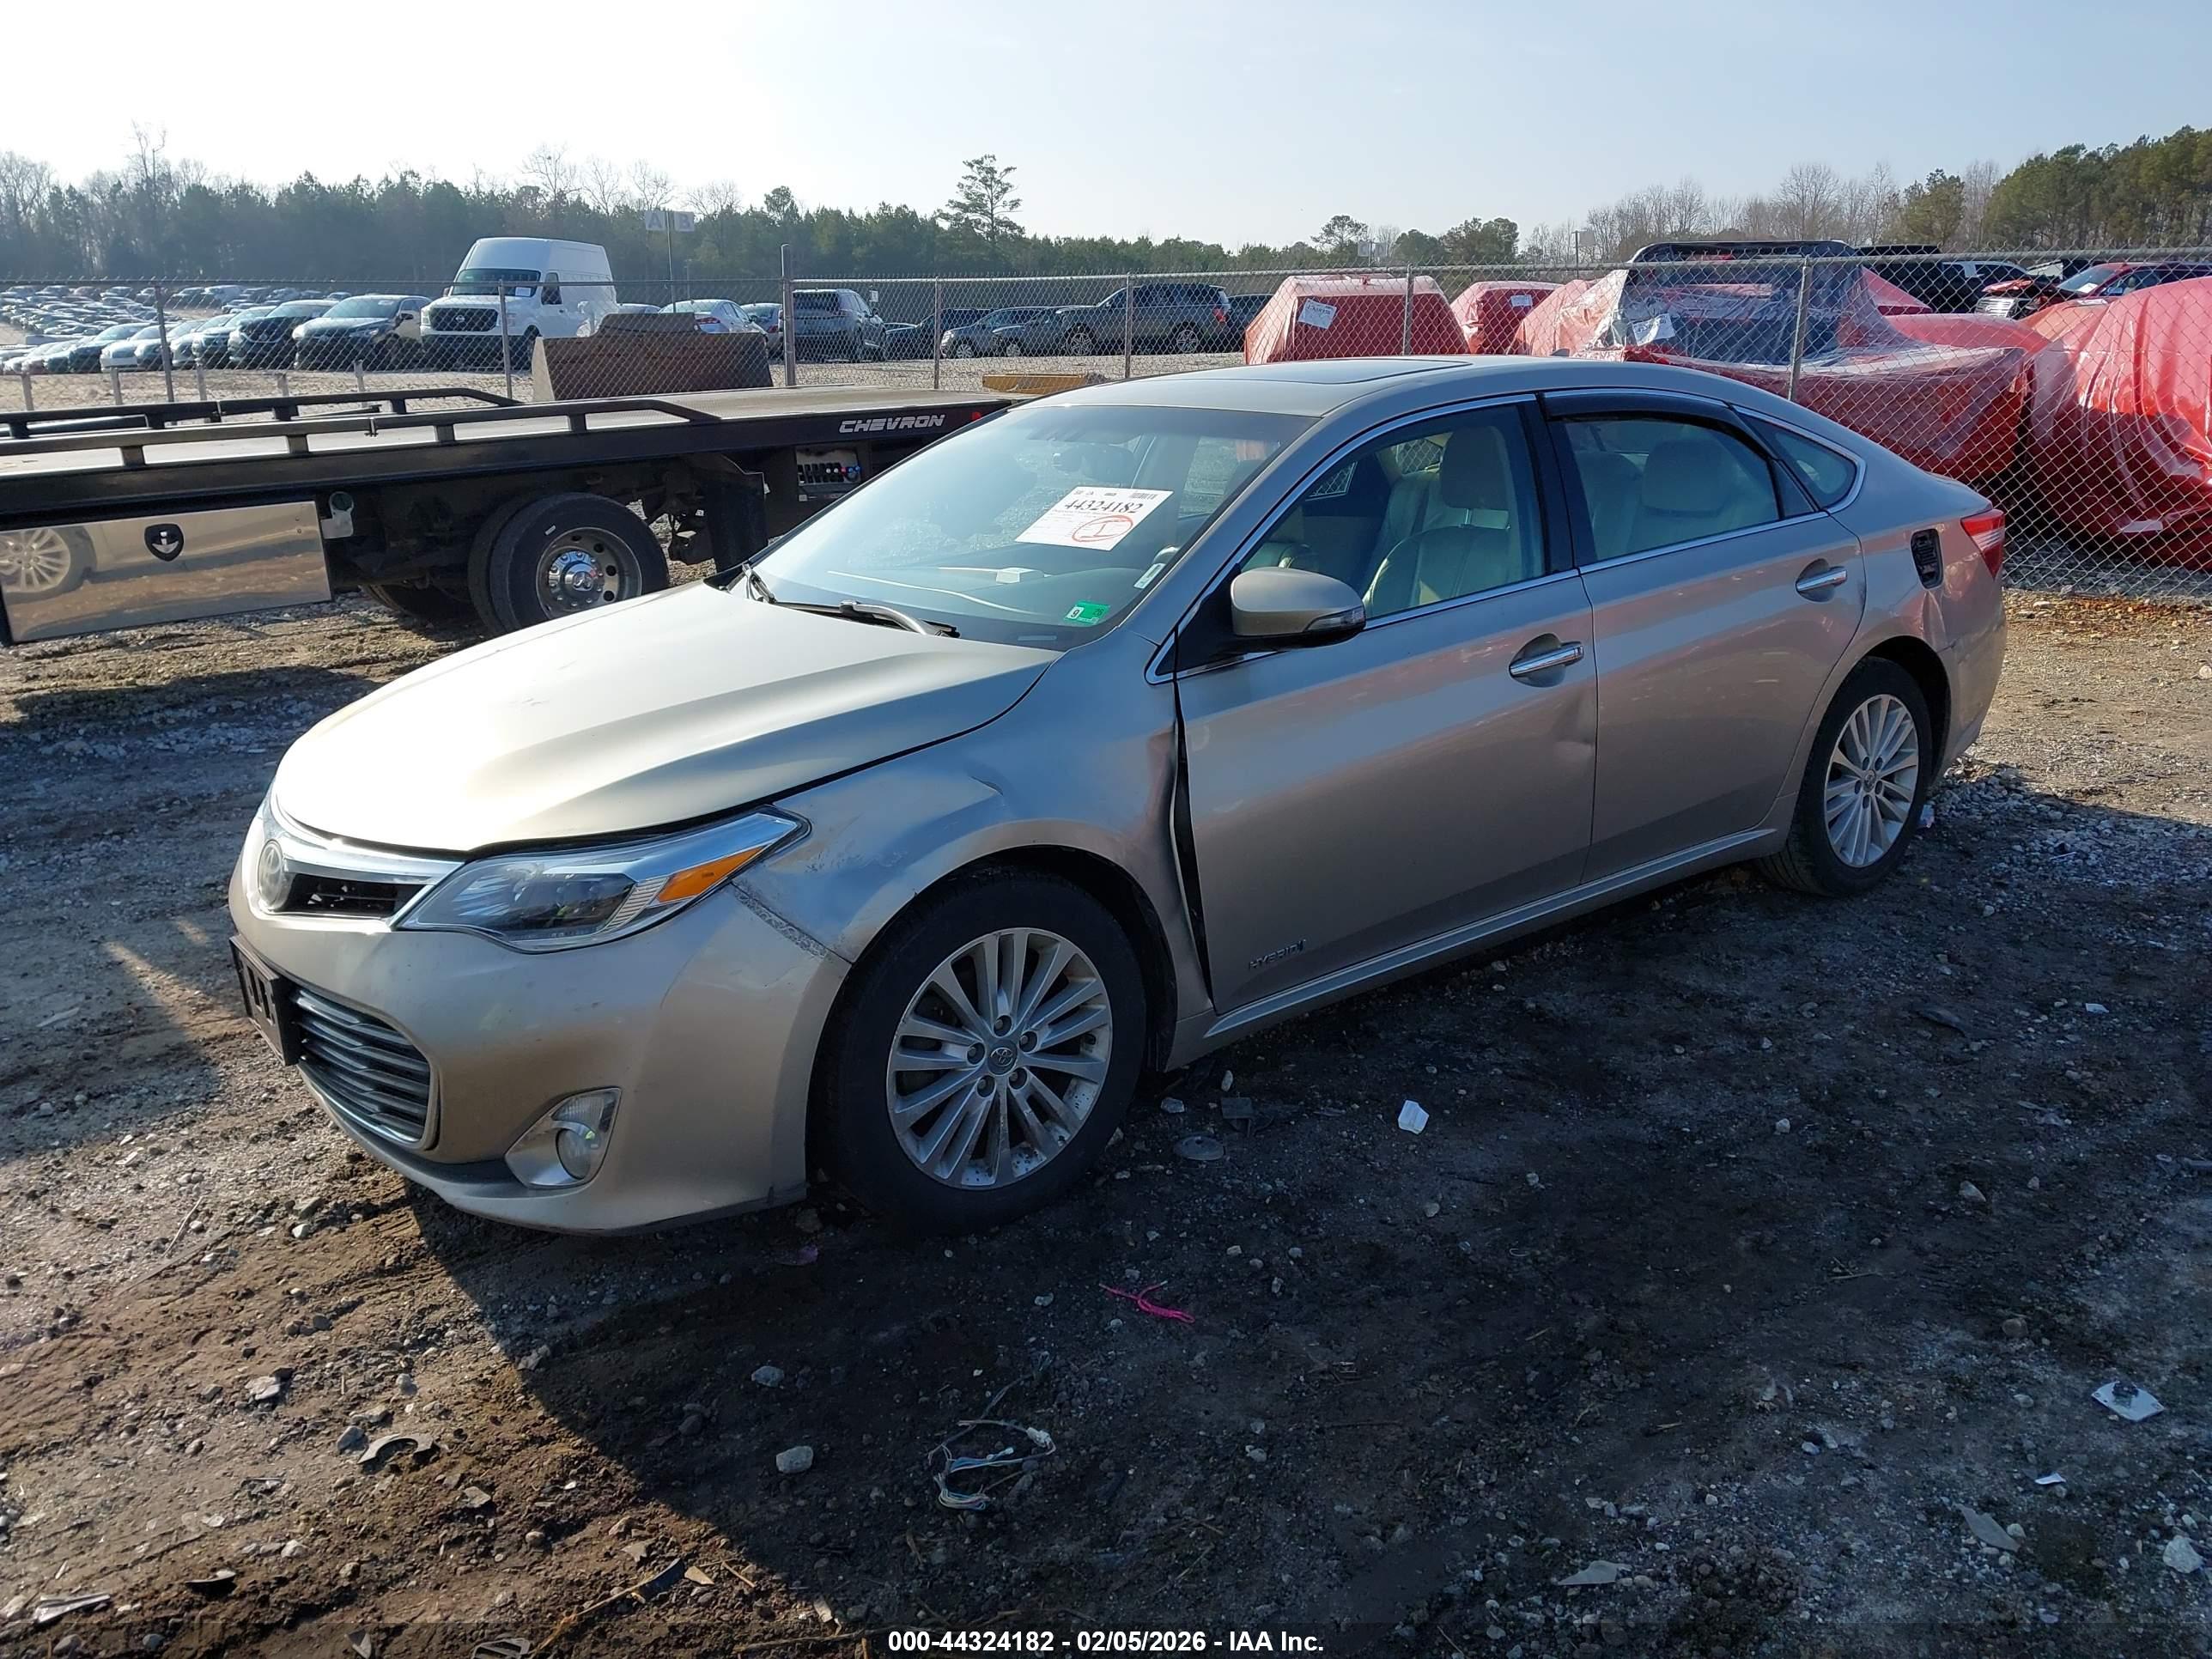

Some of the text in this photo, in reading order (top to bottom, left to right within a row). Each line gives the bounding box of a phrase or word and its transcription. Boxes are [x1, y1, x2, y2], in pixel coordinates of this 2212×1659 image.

[648, 212, 663, 228] A
[678, 214, 690, 229] B
[839, 414, 945, 434] CHEVRON
[1065, 499, 1144, 514] 44324182
[1070, 608, 1080, 618] 9
